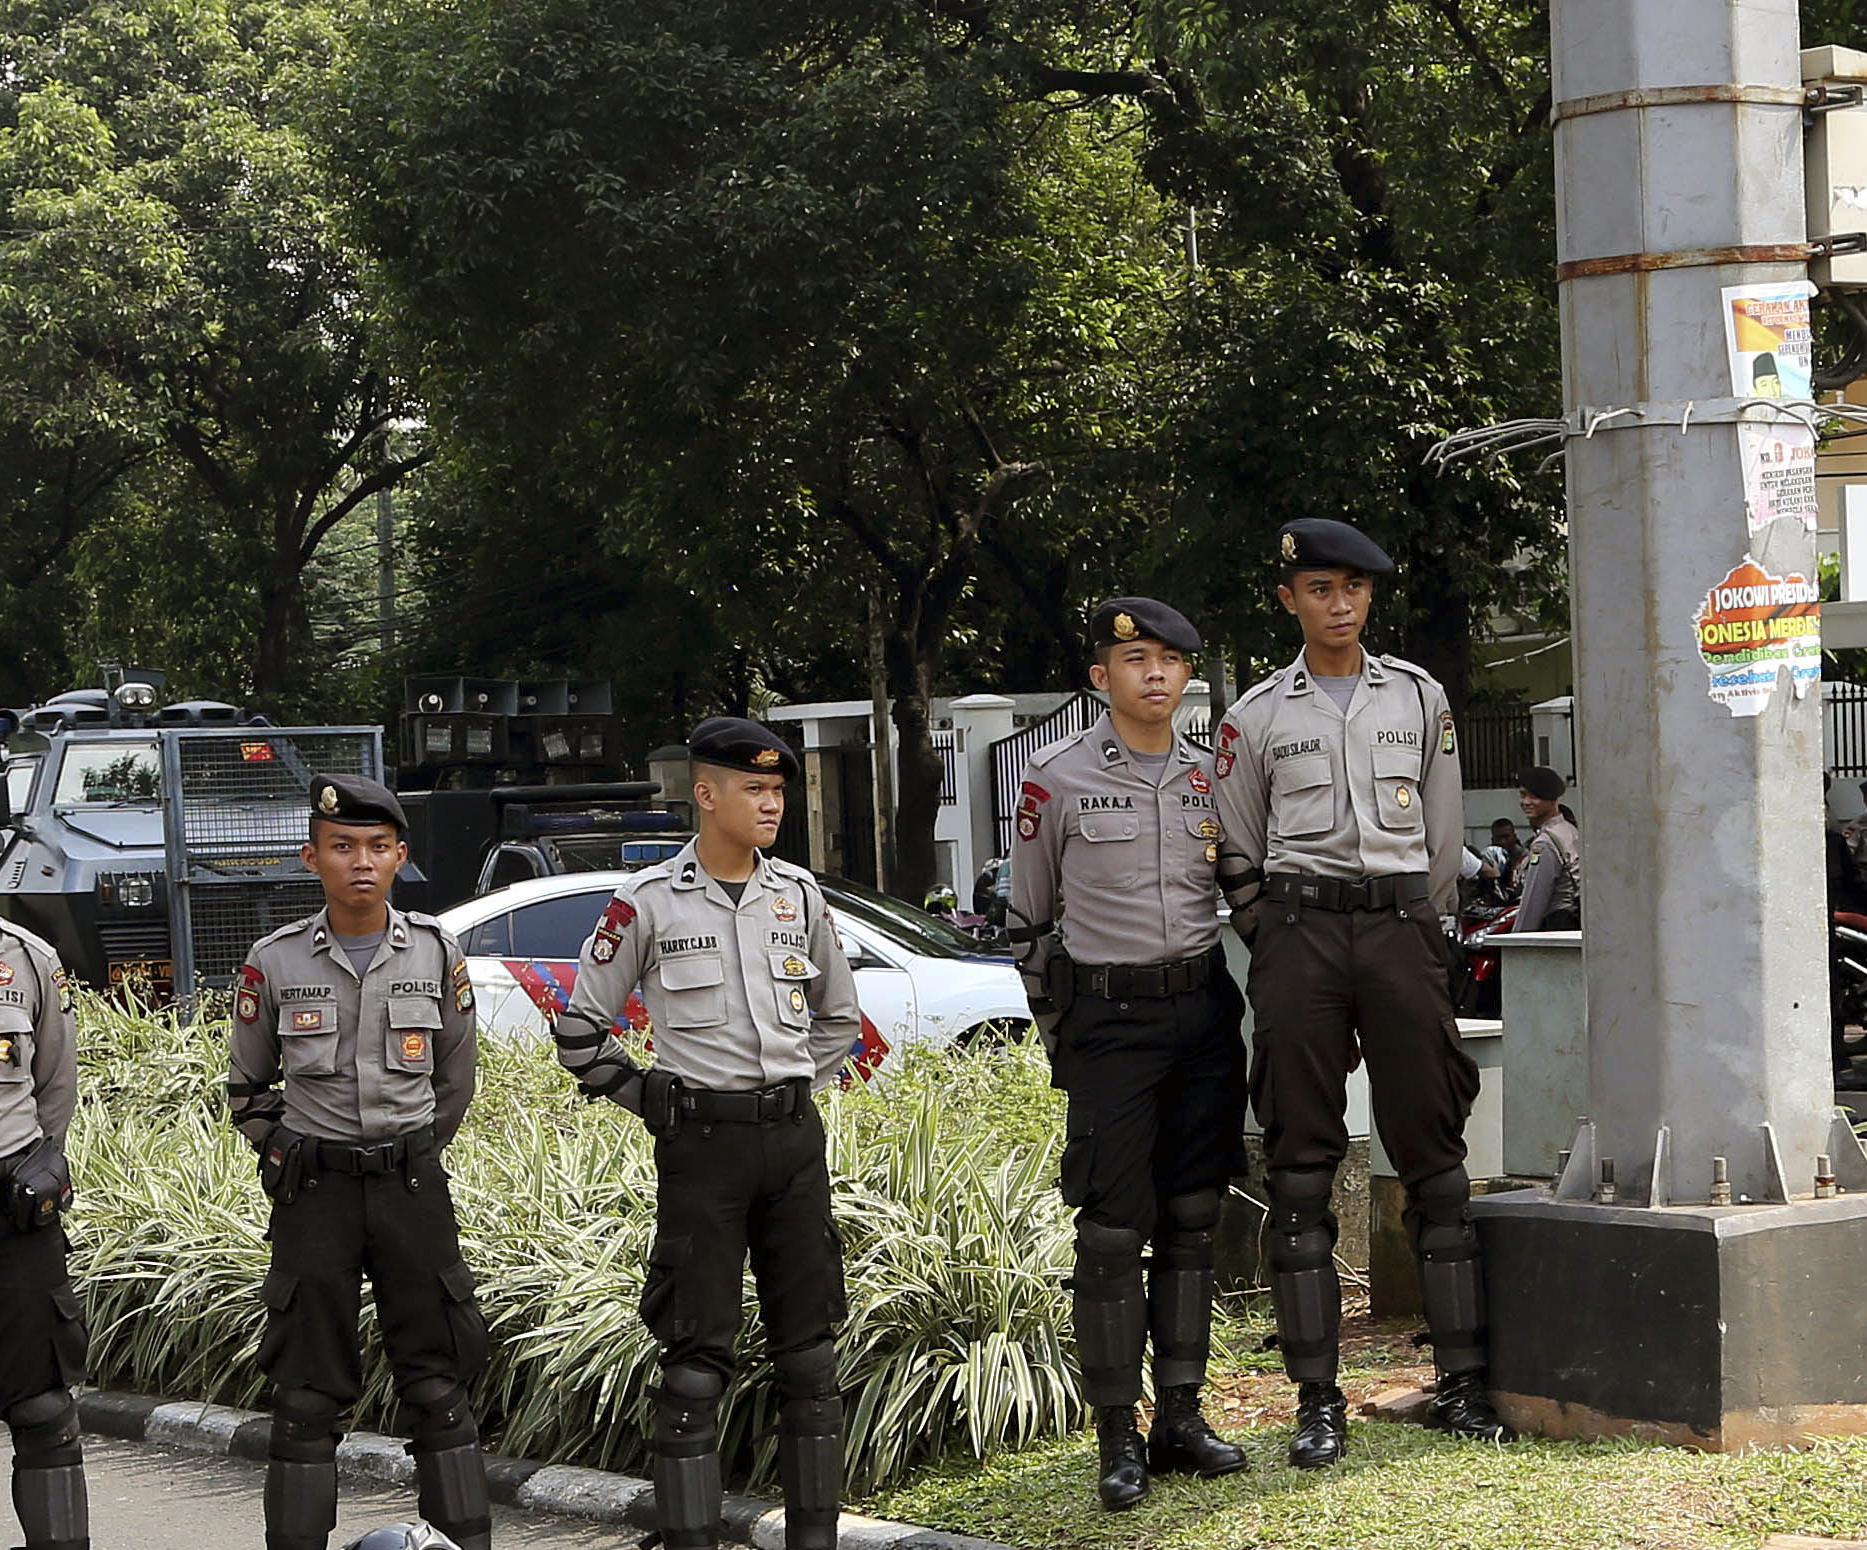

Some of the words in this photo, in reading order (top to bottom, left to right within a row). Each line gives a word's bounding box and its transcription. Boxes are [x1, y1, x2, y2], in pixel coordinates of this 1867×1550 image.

[1714, 584, 1769, 612] JOKOWI
[1377, 731, 1419, 746] POLISI
[390, 982, 439, 996] POLISI
